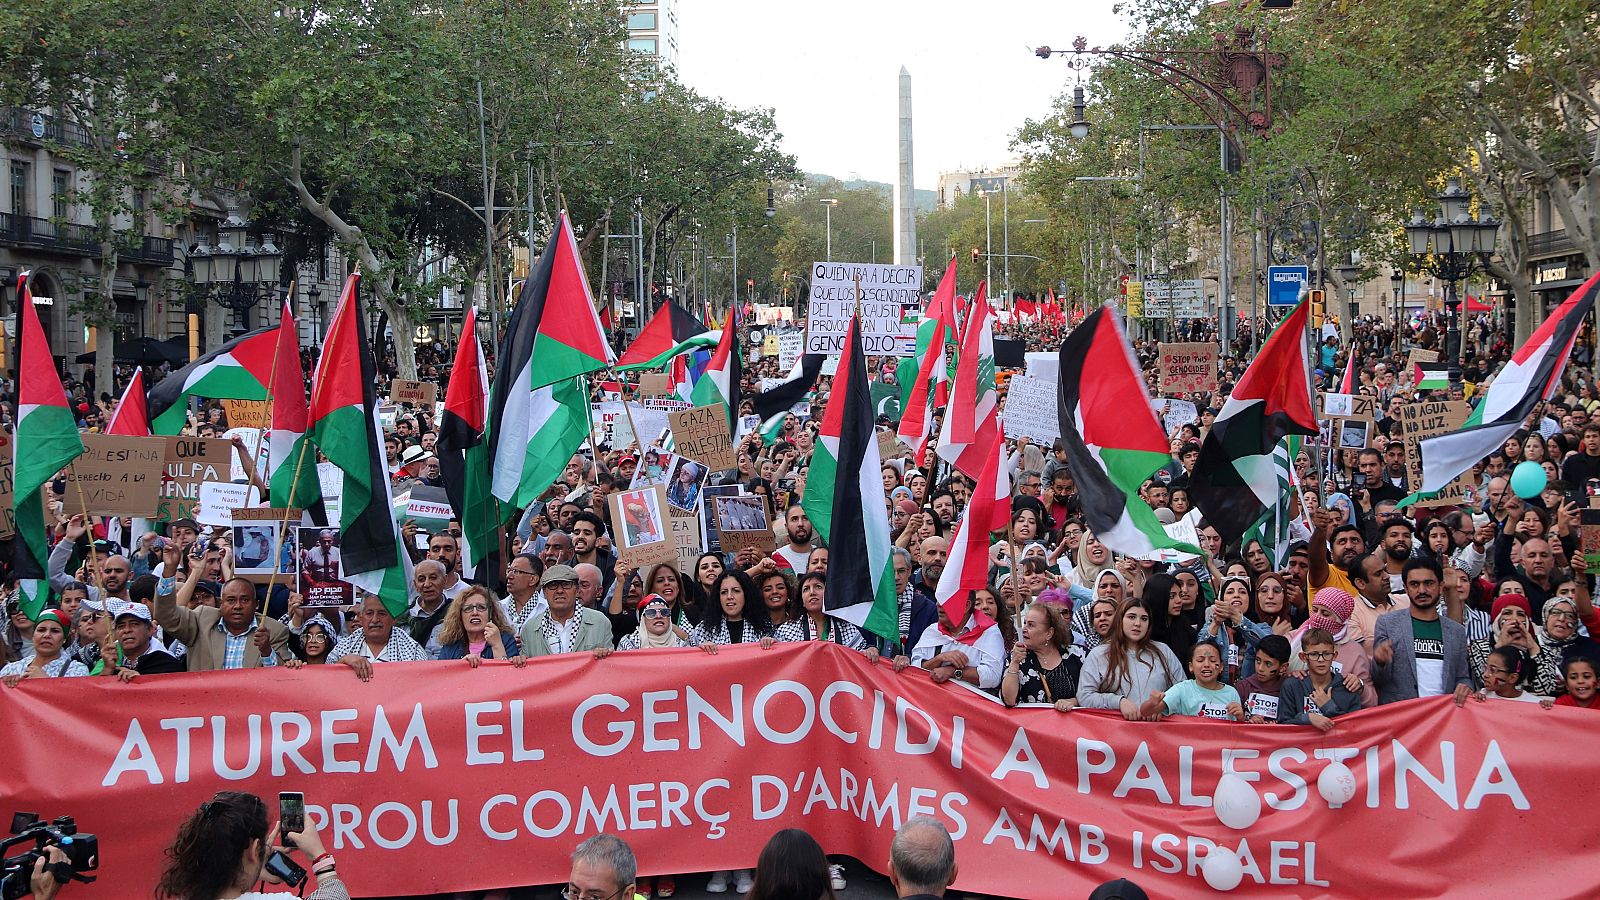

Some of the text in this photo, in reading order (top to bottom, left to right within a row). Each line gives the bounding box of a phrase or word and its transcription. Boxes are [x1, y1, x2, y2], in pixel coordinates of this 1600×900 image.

[882, 268, 916, 285] DECIR
[814, 286, 835, 301] QUE
[837, 288, 855, 301] LOS
[812, 302, 833, 317] DEL
[886, 320, 901, 333] UN
[1172, 356, 1190, 364] STOP
[679, 408, 715, 427] GAZA
[1403, 406, 1416, 420] NO
[1406, 421, 1419, 433] NO
[80, 446, 158, 461] PALESTINA
[176, 440, 206, 457] QUE
[68, 473, 146, 482] DERECHO A LA
[86, 489, 126, 503] VIDA
[407, 503, 450, 515] ALESTINA
[1255, 699, 1278, 708] STOP
[1204, 708, 1227, 716] STOP
[102, 703, 438, 787] ATUREM
[464, 699, 545, 765] EL
[571, 680, 965, 769] GENOCIDI
[991, 727, 1050, 789] A
[304, 798, 459, 850] PROU
[479, 778, 731, 839] COMERÇ
[982, 806, 1110, 865] AMB
